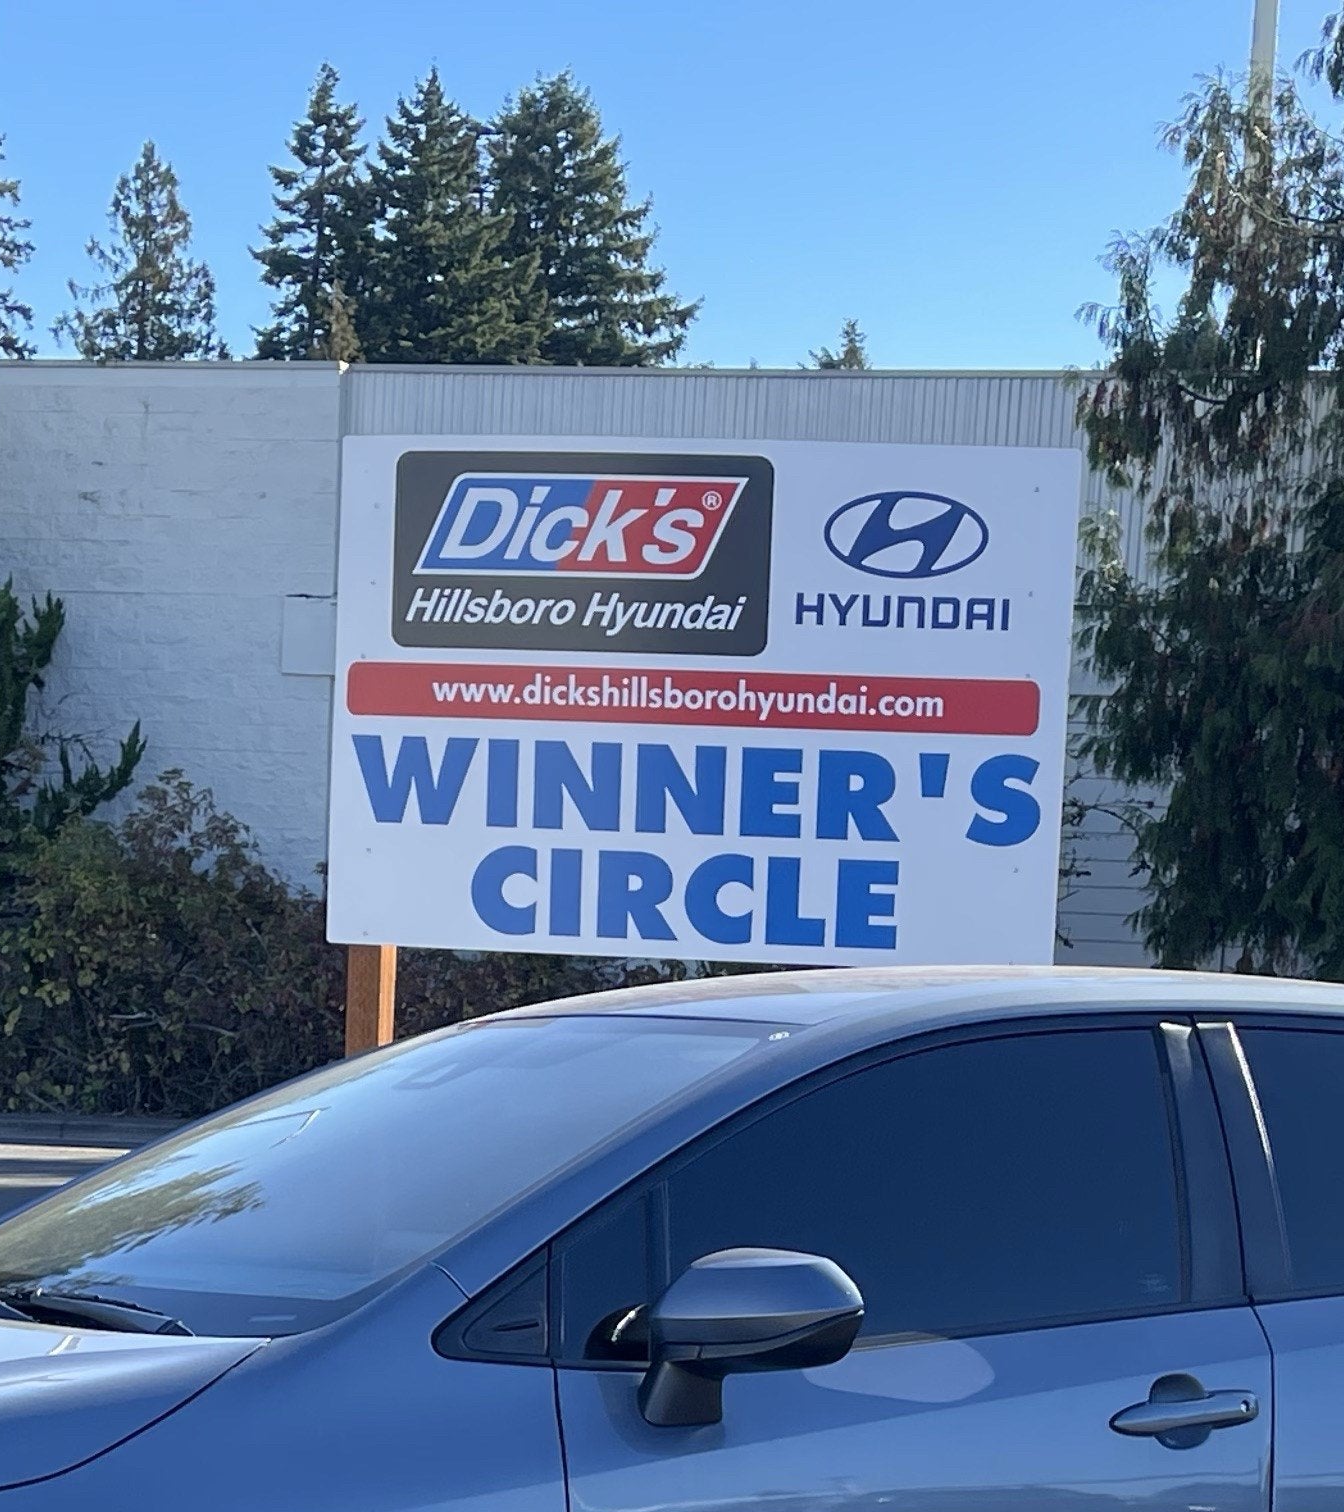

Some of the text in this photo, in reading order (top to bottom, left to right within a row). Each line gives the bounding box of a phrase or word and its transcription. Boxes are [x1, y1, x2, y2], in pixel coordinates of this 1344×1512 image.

[439, 486, 704, 566] Dick's
[406, 588, 747, 637] Hillsboro Hyundai
[795, 592, 1010, 631] HYUNDAI
[432, 675, 945, 721] www.dickshillsborohyundai.com
[351, 733, 1041, 847] WINNER'S
[470, 845, 900, 950] CIRCLE
